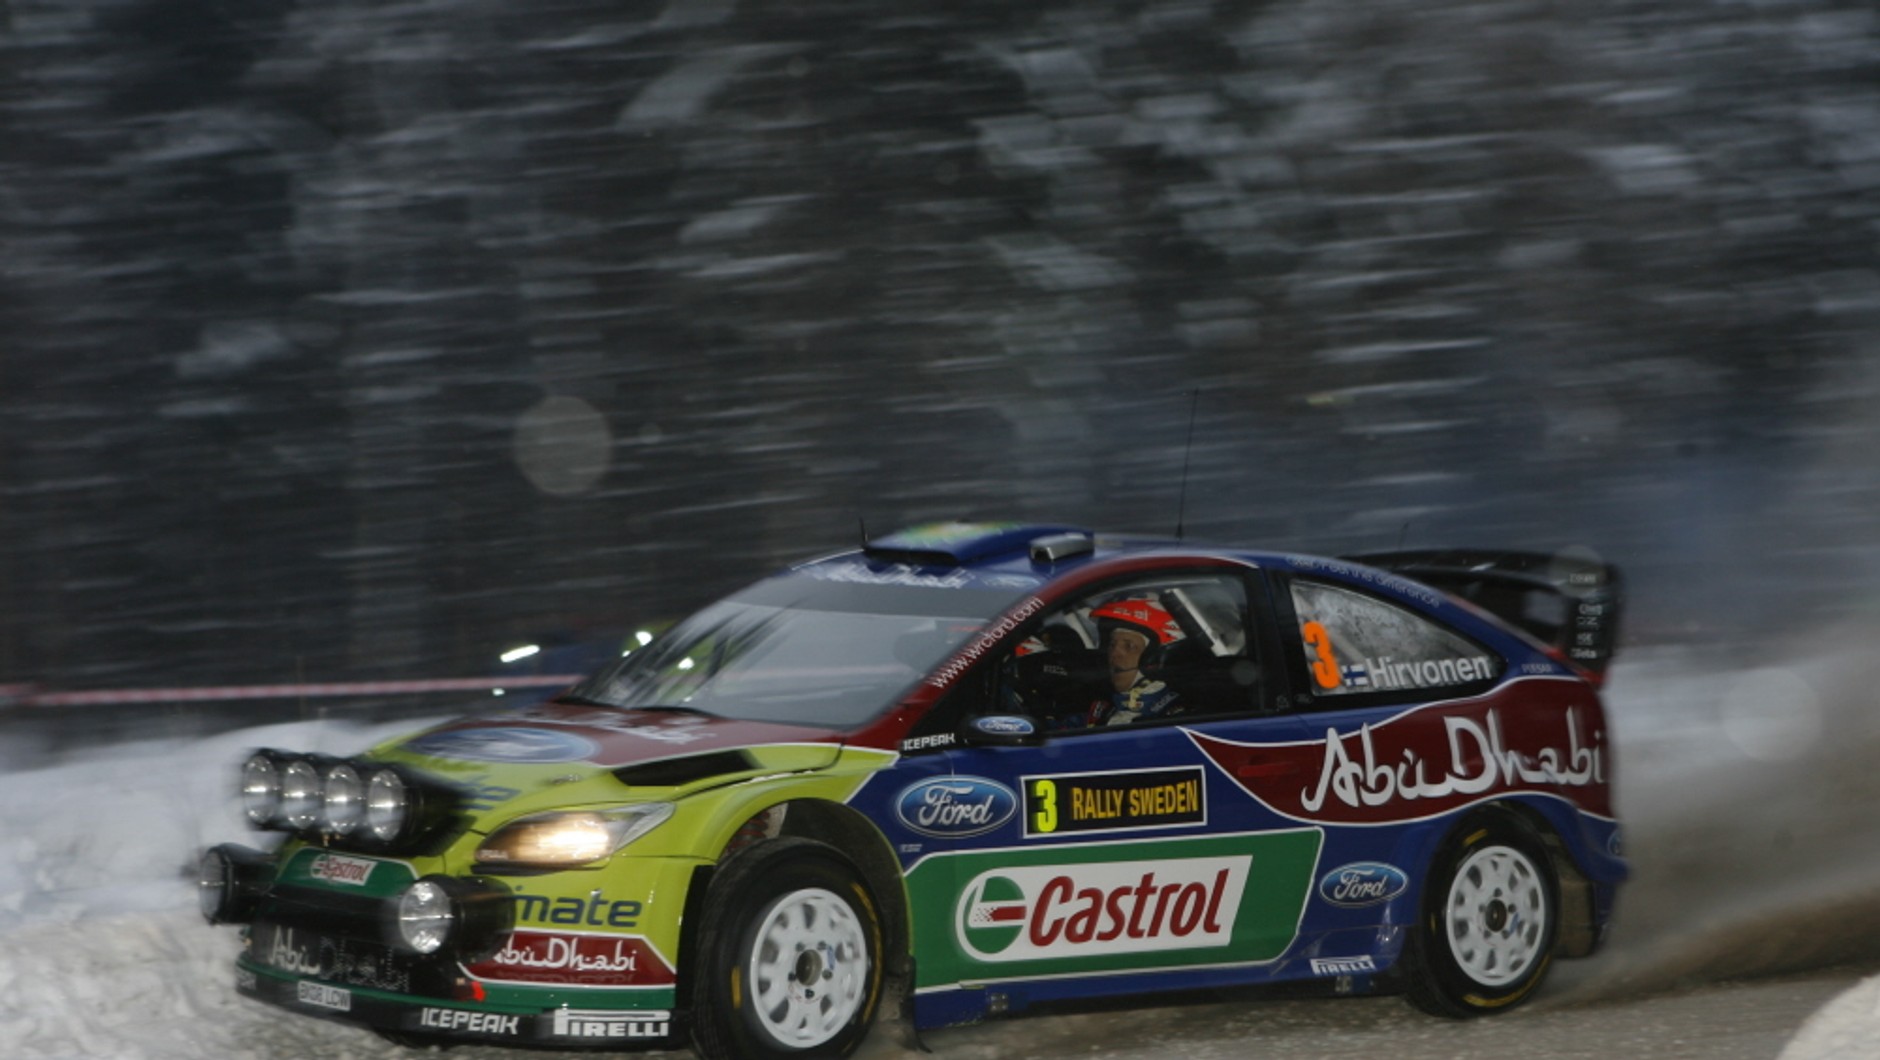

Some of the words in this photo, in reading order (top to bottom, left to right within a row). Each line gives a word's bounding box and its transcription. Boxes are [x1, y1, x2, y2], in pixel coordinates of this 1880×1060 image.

[1303, 621, 1341, 689] 3
[1365, 655, 1492, 689] Hirvonen
[903, 733, 956, 751] ICEPEAK
[918, 785, 995, 827] Ford
[1035, 780, 1058, 832] 3
[1071, 786, 1124, 821] RALLY
[1129, 780, 1198, 816] SWEDEN
[323, 857, 371, 882] Castrol
[1333, 872, 1388, 900] Ford
[1028, 868, 1230, 947] Castrol
[1310, 955, 1377, 976] PIRELLI
[421, 1007, 520, 1036] ICEPEAK
[553, 1009, 671, 1037] PIRELLI
